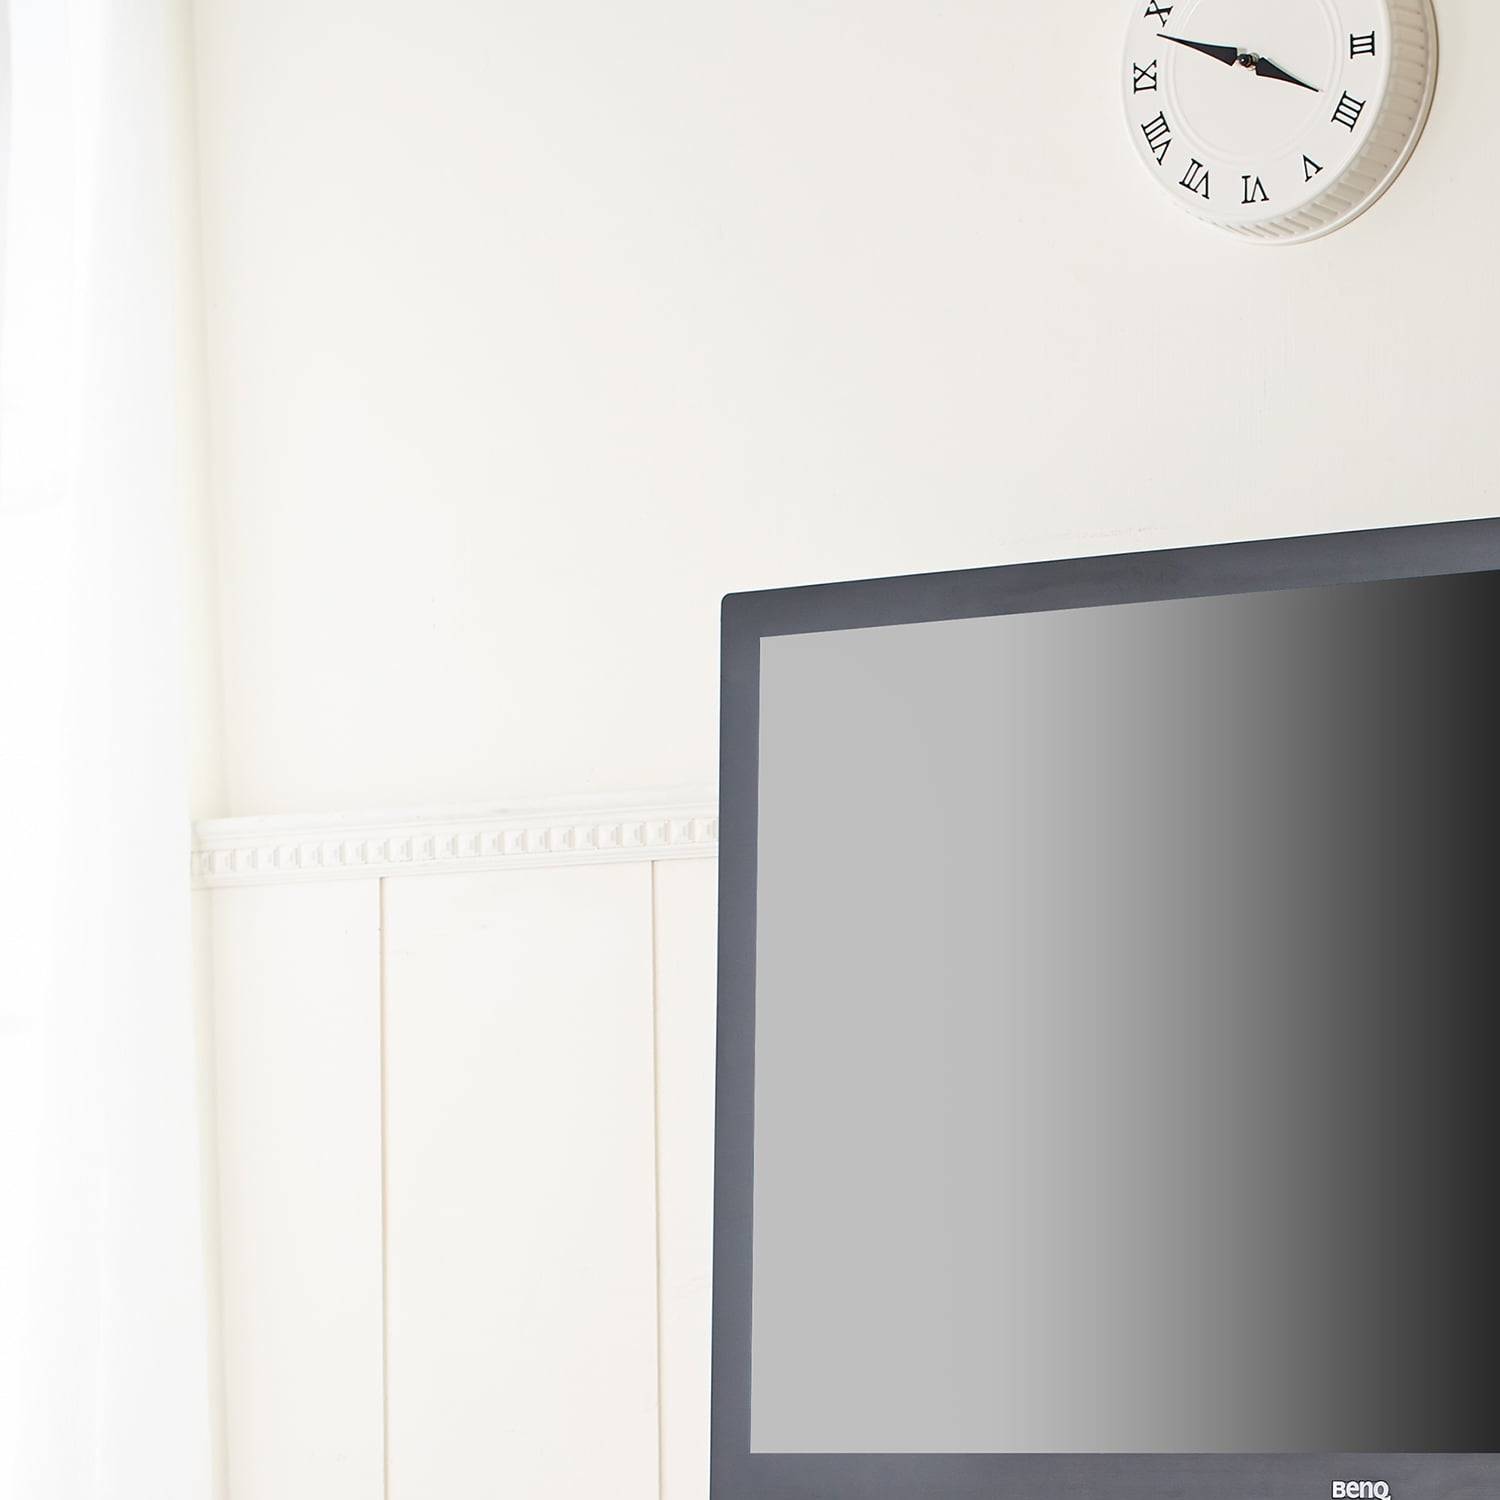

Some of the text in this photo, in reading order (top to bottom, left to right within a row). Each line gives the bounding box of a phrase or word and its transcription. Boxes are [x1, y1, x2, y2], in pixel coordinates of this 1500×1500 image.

[1350, 30, 1375, 59] III
[1133, 59, 1157, 94] IX
[1331, 90, 1366, 132] IIII
[1141, 111, 1173, 165] VIII
[1179, 158, 1210, 199] VII
[1302, 154, 1323, 182] V
[1241, 176, 1269, 204] VI
